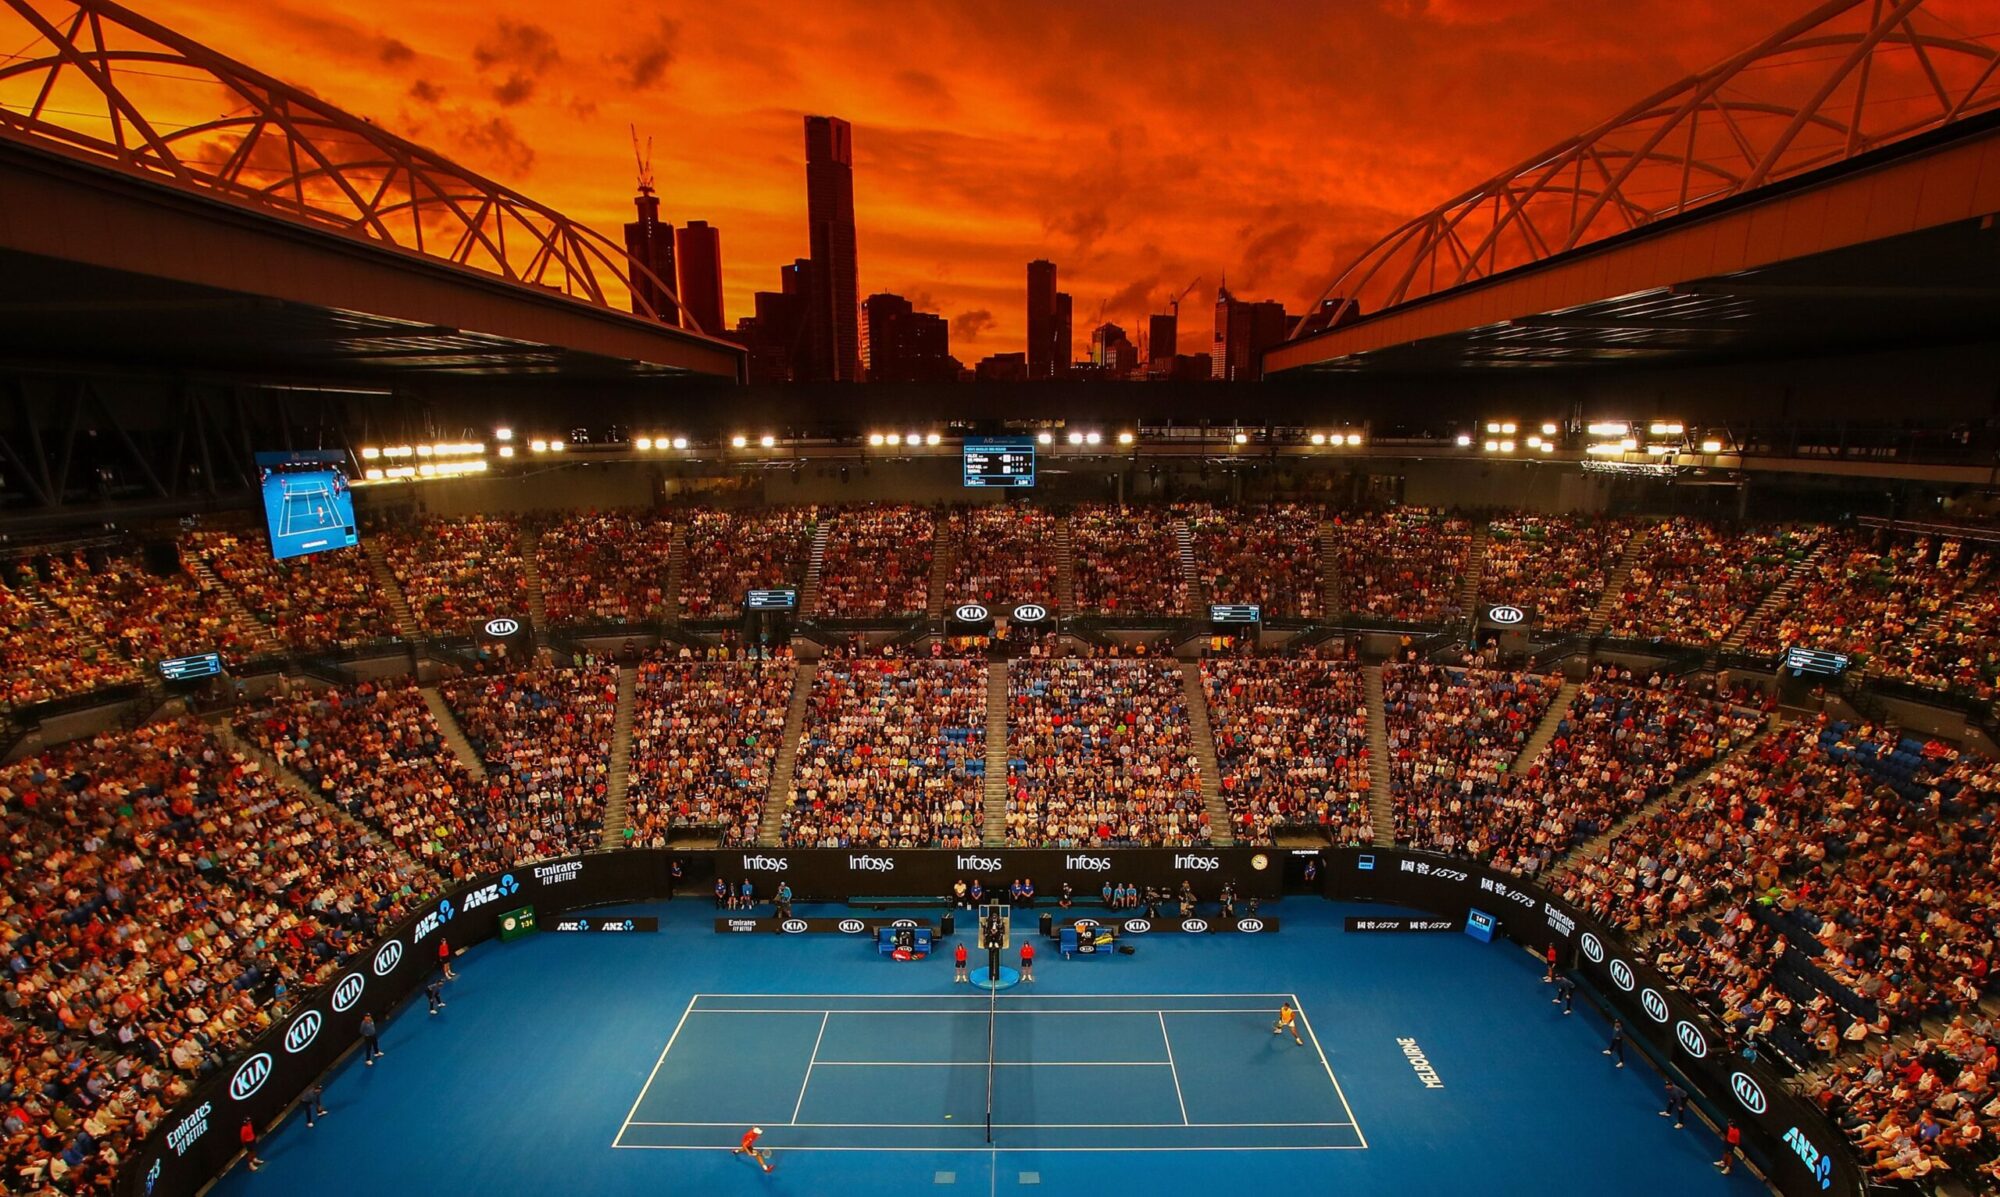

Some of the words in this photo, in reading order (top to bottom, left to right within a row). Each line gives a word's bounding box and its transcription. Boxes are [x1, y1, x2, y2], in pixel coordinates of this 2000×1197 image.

[534, 861, 582, 878] Emirates
[744, 854, 788, 872] Infosys
[850, 854, 894, 872] Infosys
[958, 854, 1002, 872] Infosys
[1066, 854, 1110, 872] Infosys
[1174, 854, 1219, 872] Infosys
[555, 871, 576, 882] BETTER
[463, 884, 499, 912] ANZ
[1545, 902, 1575, 930] Emirates
[414, 911, 440, 944] ANZ
[557, 922, 578, 930] ANZ
[602, 922, 623, 930] ANZ
[1396, 1038, 1444, 1088] MELBOURNE
[167, 1101, 212, 1149] Emirates
[1782, 1127, 1818, 1173] ANZ
